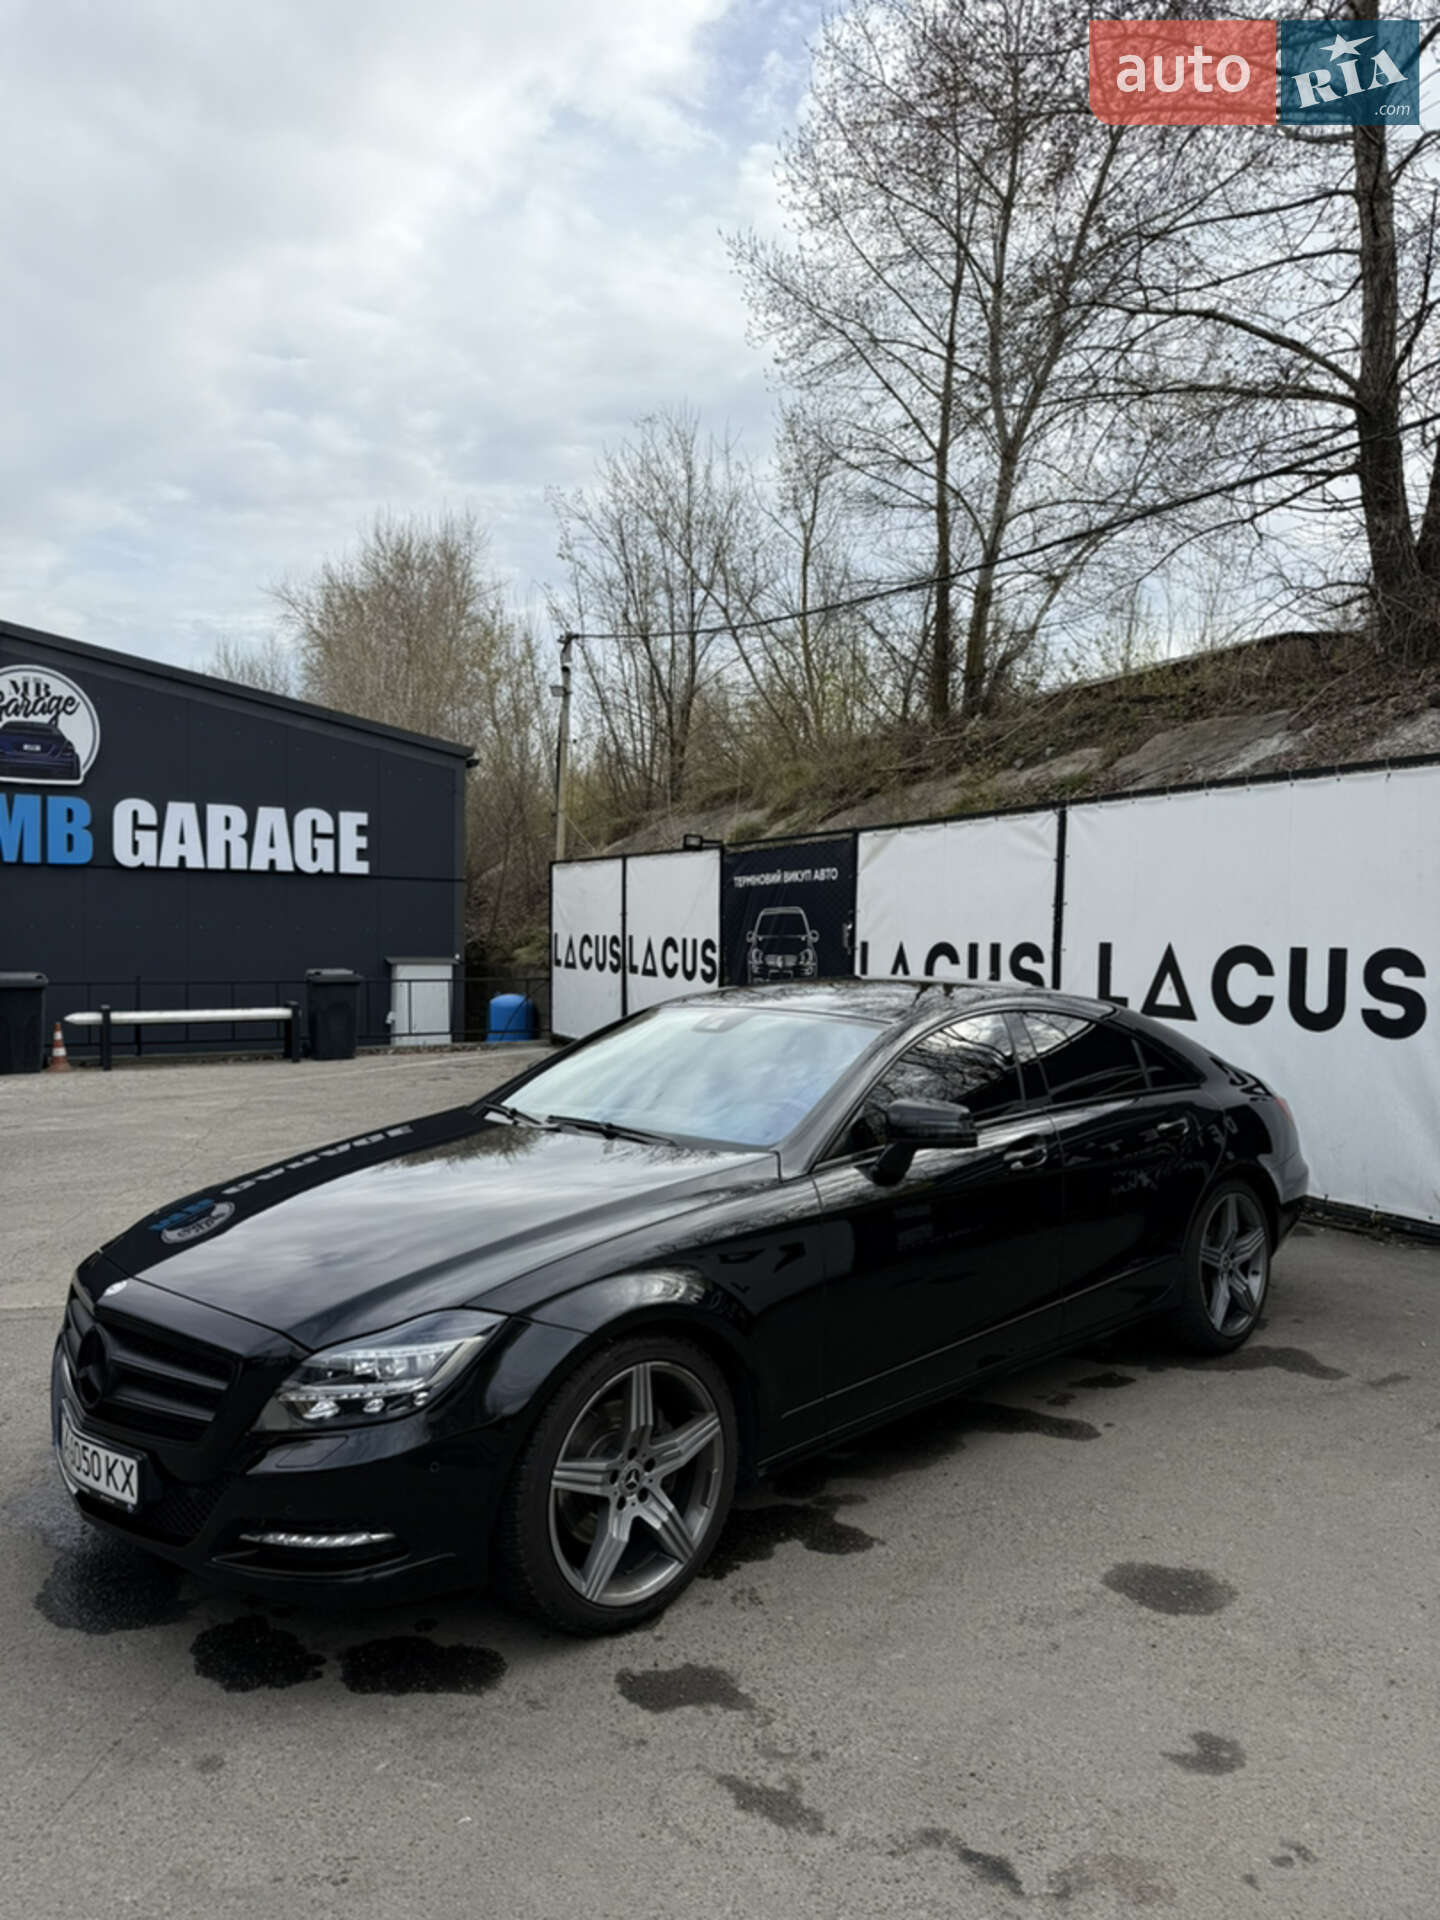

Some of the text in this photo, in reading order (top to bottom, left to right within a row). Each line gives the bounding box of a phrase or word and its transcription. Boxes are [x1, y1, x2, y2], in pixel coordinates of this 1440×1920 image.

[0, 689, 81, 728] arage
[0, 794, 370, 875] MB GARAGE
[814, 867, 839, 881] АВТО
[554, 932, 621, 974] LACUS
[628, 934, 717, 984] LACUS
[1097, 941, 1427, 1040] LACUS
